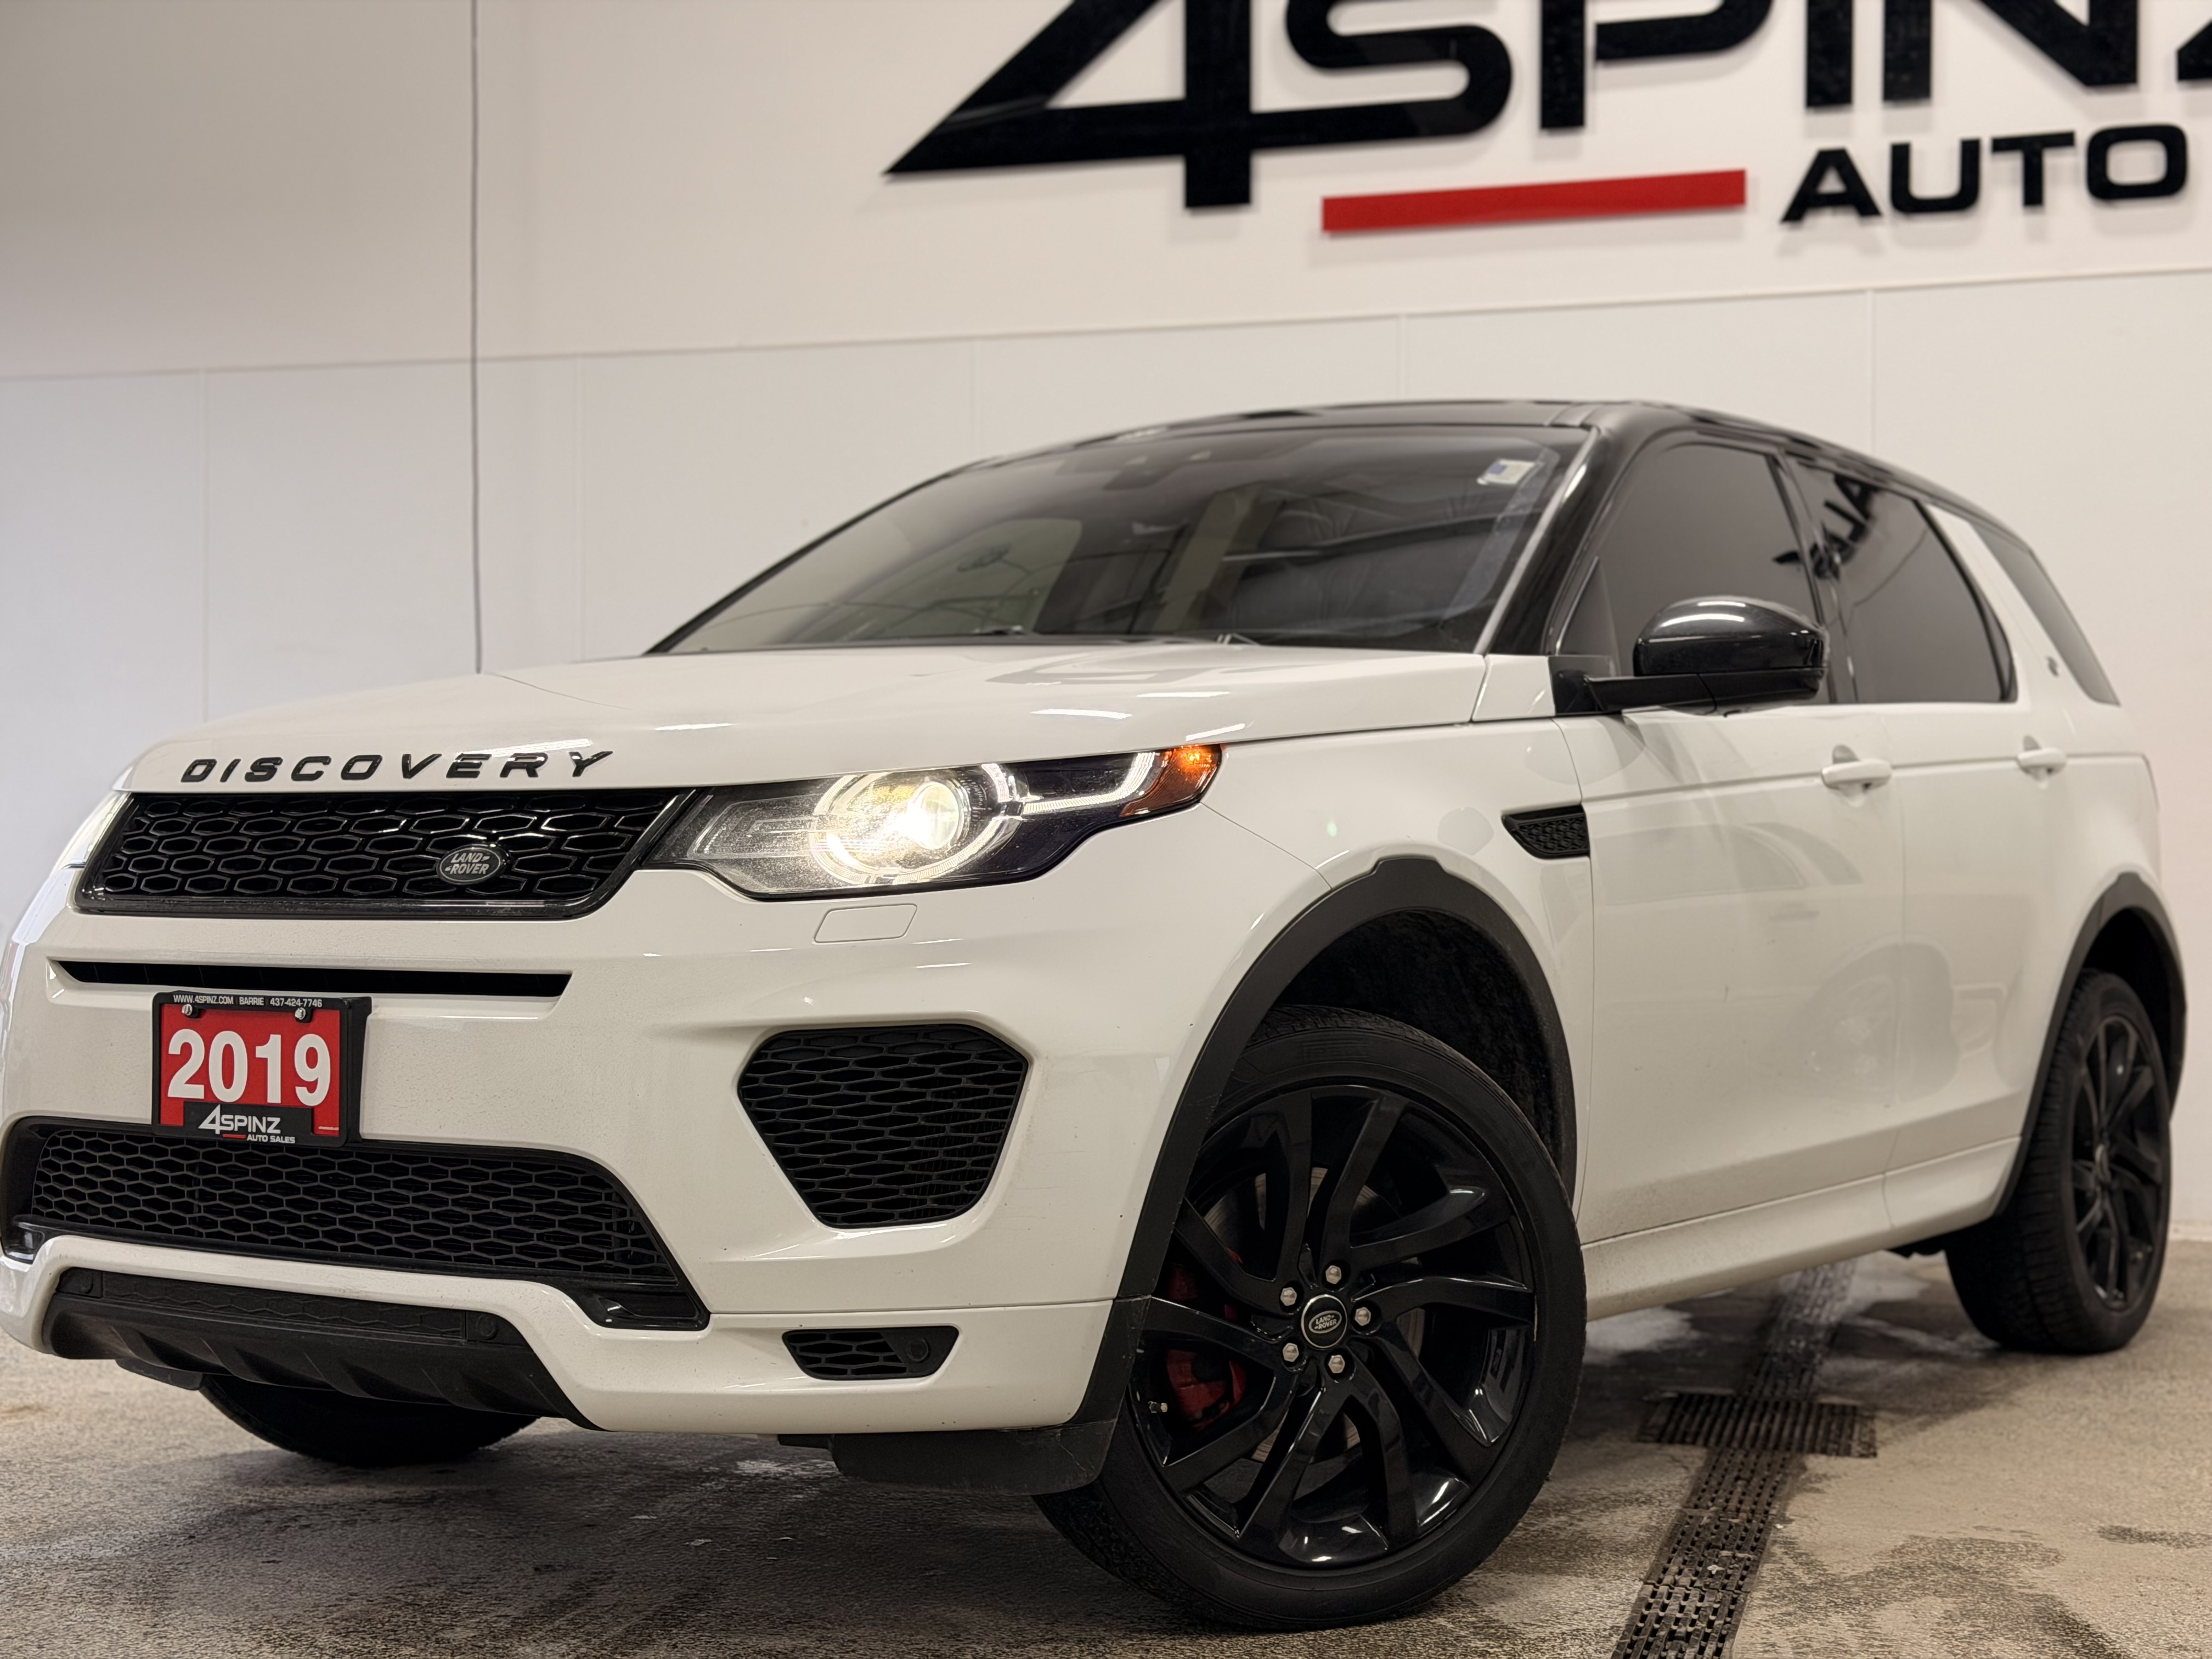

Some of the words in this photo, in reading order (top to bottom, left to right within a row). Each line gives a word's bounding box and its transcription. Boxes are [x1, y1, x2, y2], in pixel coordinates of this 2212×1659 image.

[880, 0, 2212, 209] 4SPIN
[1782, 123, 2187, 223] AUTO
[180, 751, 613, 783] DISCOVERY
[173, 994, 234, 1005] WWW.4SPINZ.COM
[239, 997, 264, 1006] BARRIE
[269, 997, 323, 1008] 437-424-7746
[168, 1029, 331, 1107] 2019
[198, 1104, 281, 1135] 4SPINZ
[246, 1133, 268, 1142] AUTO
[270, 1135, 296, 1144] SALES
